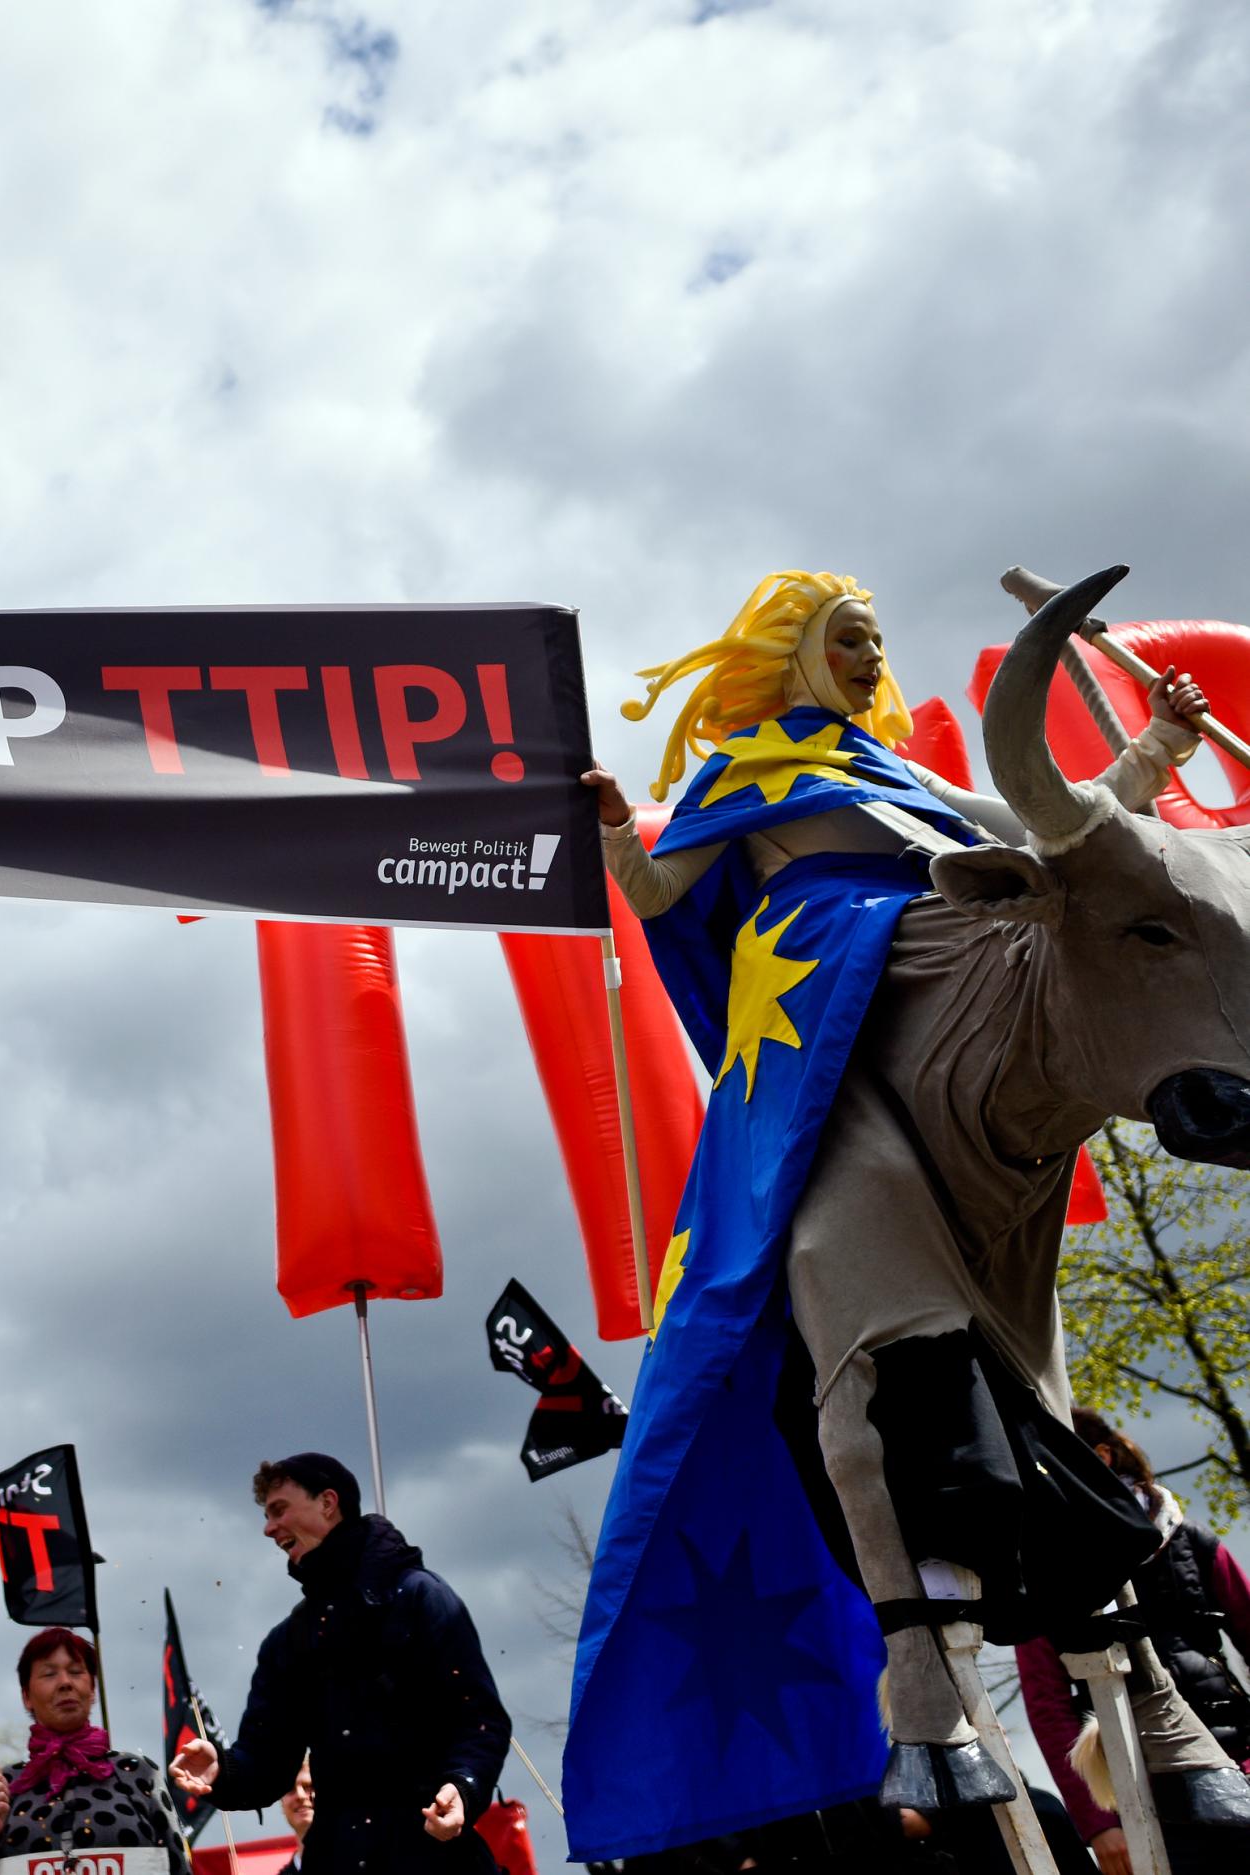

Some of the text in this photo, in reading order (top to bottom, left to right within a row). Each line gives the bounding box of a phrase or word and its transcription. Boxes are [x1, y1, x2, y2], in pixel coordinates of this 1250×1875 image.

[101, 664, 526, 784] TTIP!
[377, 834, 562, 895] campact!
[408, 837, 528, 858] Bewegt Politik
